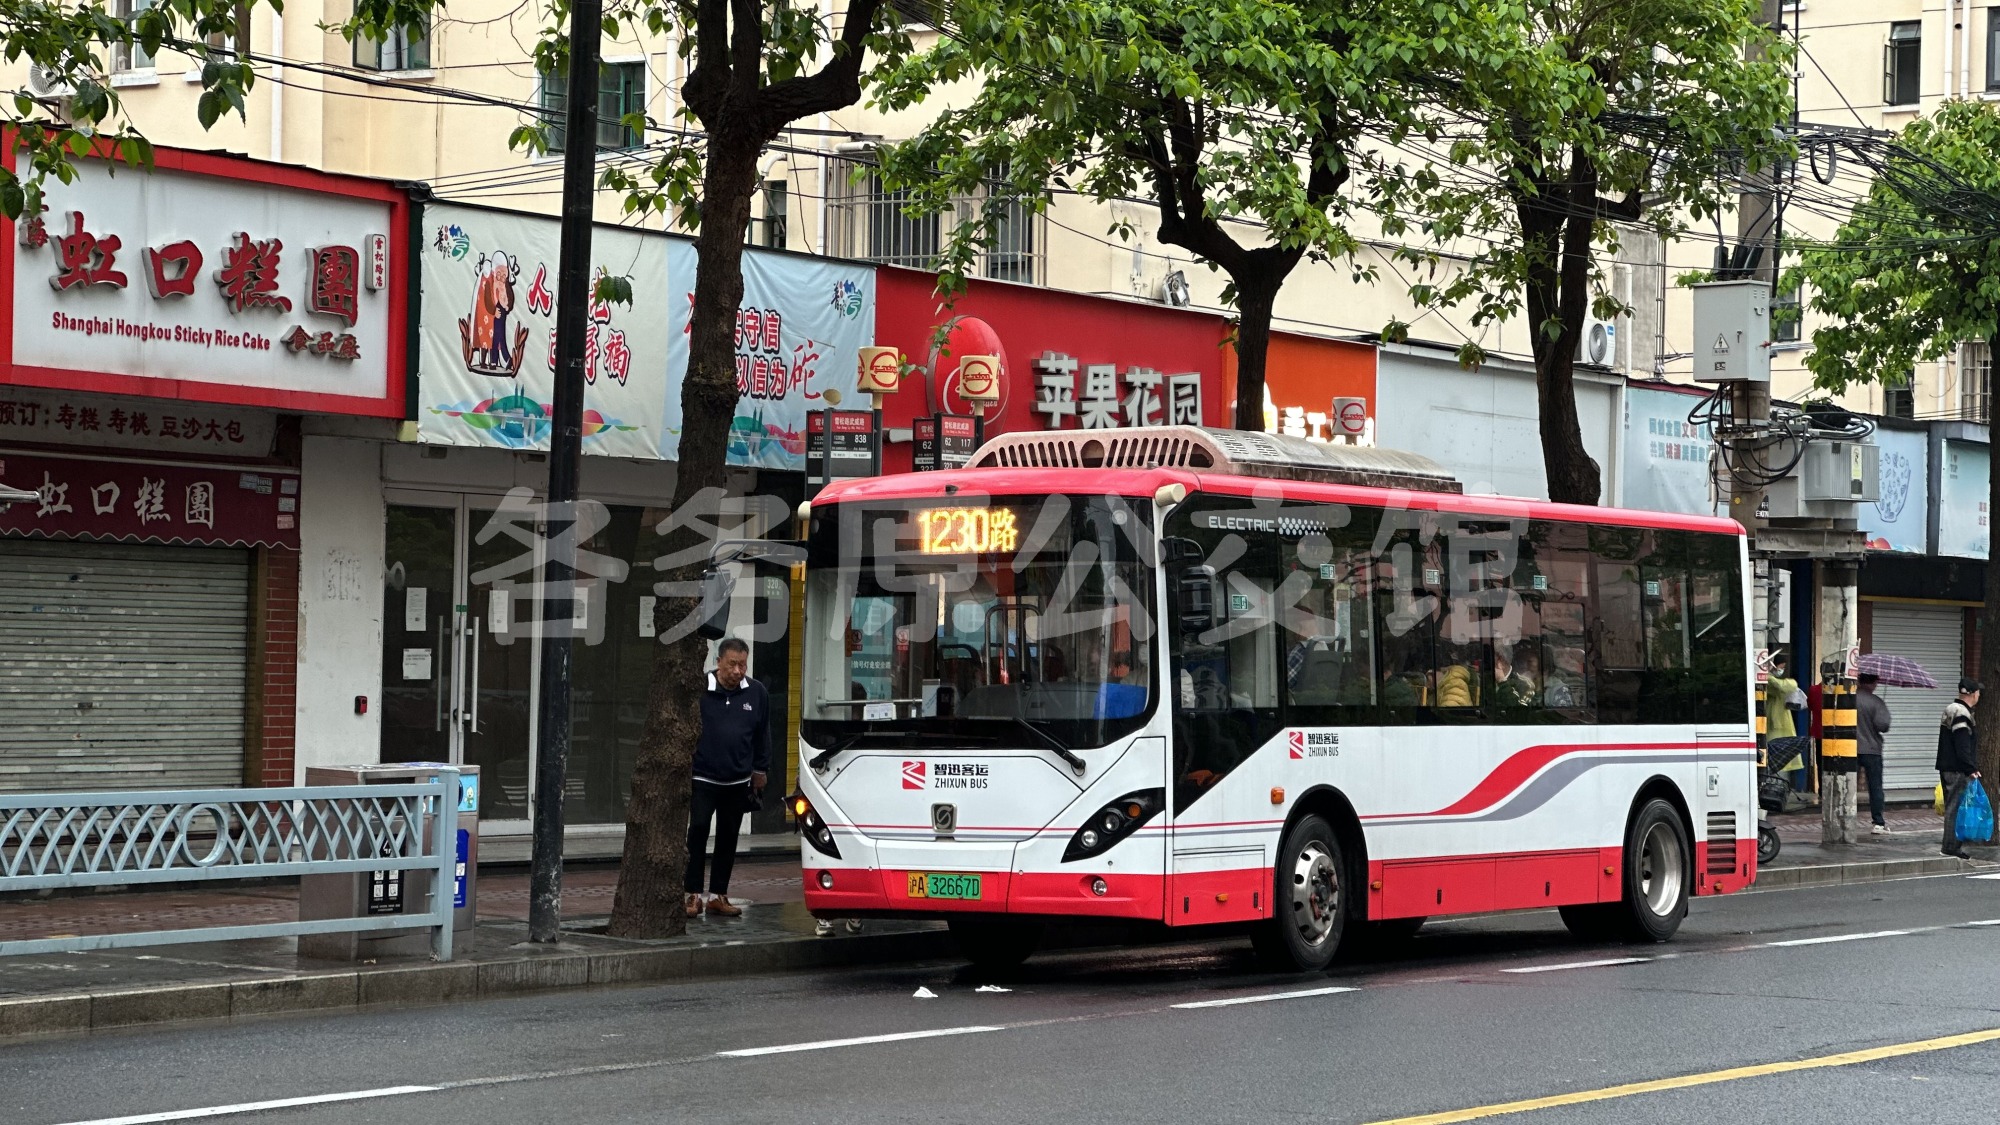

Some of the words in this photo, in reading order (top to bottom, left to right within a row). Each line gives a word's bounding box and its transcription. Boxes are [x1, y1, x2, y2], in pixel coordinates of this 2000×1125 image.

[52, 311, 113, 336] Shanghai
[116, 319, 172, 342] Hongkou
[174, 325, 213, 348] Sticky
[214, 329, 240, 348] Rice
[242, 332, 271, 351] Cake
[1032, 351, 1204, 429] 苹果花园
[55, 403, 100, 432] 寿糕
[107, 407, 151, 436] 寿桃
[159, 414, 245, 443] 豆沙大包
[854, 434, 867, 443] 838
[922, 441, 932, 450] 62
[944, 437, 952, 446] 62
[961, 438, 971, 447] 117
[36, 470, 214, 530] 虹口糕團
[918, 506, 1018, 555] 1230路
[1208, 516, 1275, 534] ELECTRIC
[1307, 733, 1339, 745] 智迅客运
[1308, 746, 1328, 757] ZHIXUN
[1328, 746, 1339, 757] BUS
[934, 763, 989, 776] 智迅客运
[934, 777, 967, 789] ZHIXUN
[970, 778, 988, 789] BUS
[909, 876, 926, 895] 沪A
[931, 876, 980, 897] 32667D
